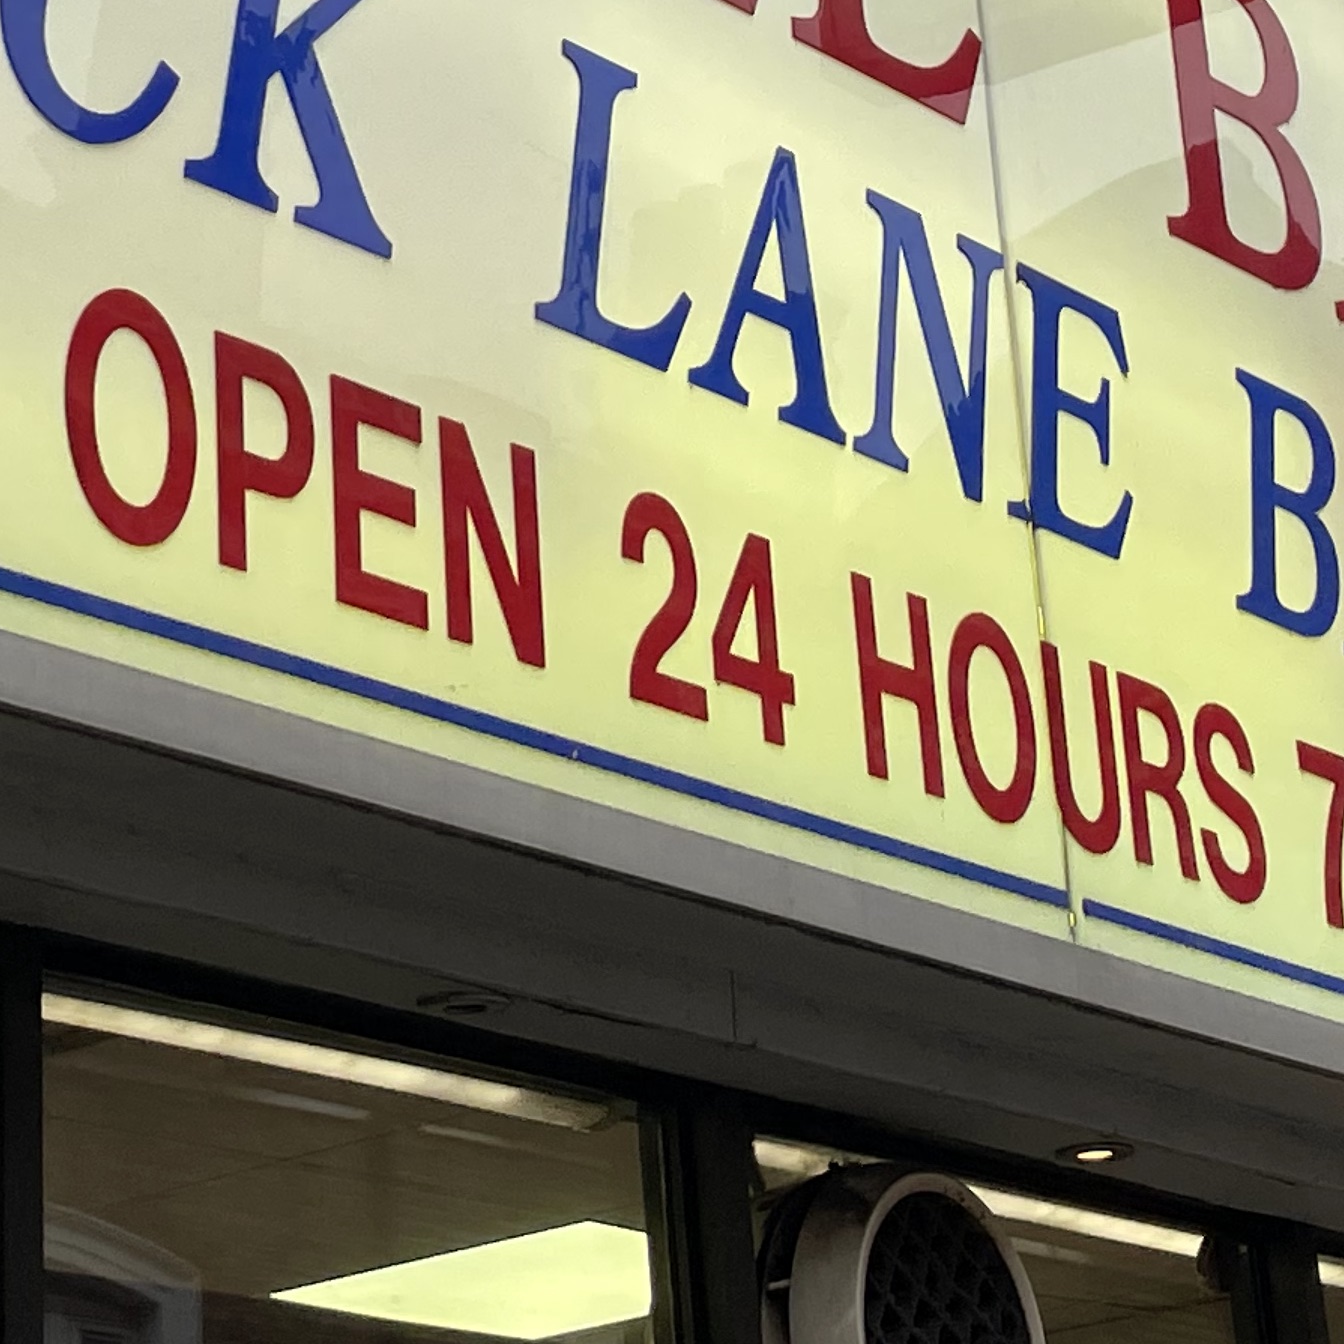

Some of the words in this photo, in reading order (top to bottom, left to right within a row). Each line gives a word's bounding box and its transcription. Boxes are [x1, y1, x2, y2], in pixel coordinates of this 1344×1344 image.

[536, 40, 1132, 560] LANE
[64, 287, 547, 669] OPEN
[620, 491, 796, 747] 24
[850, 571, 1267, 905] HOURS
